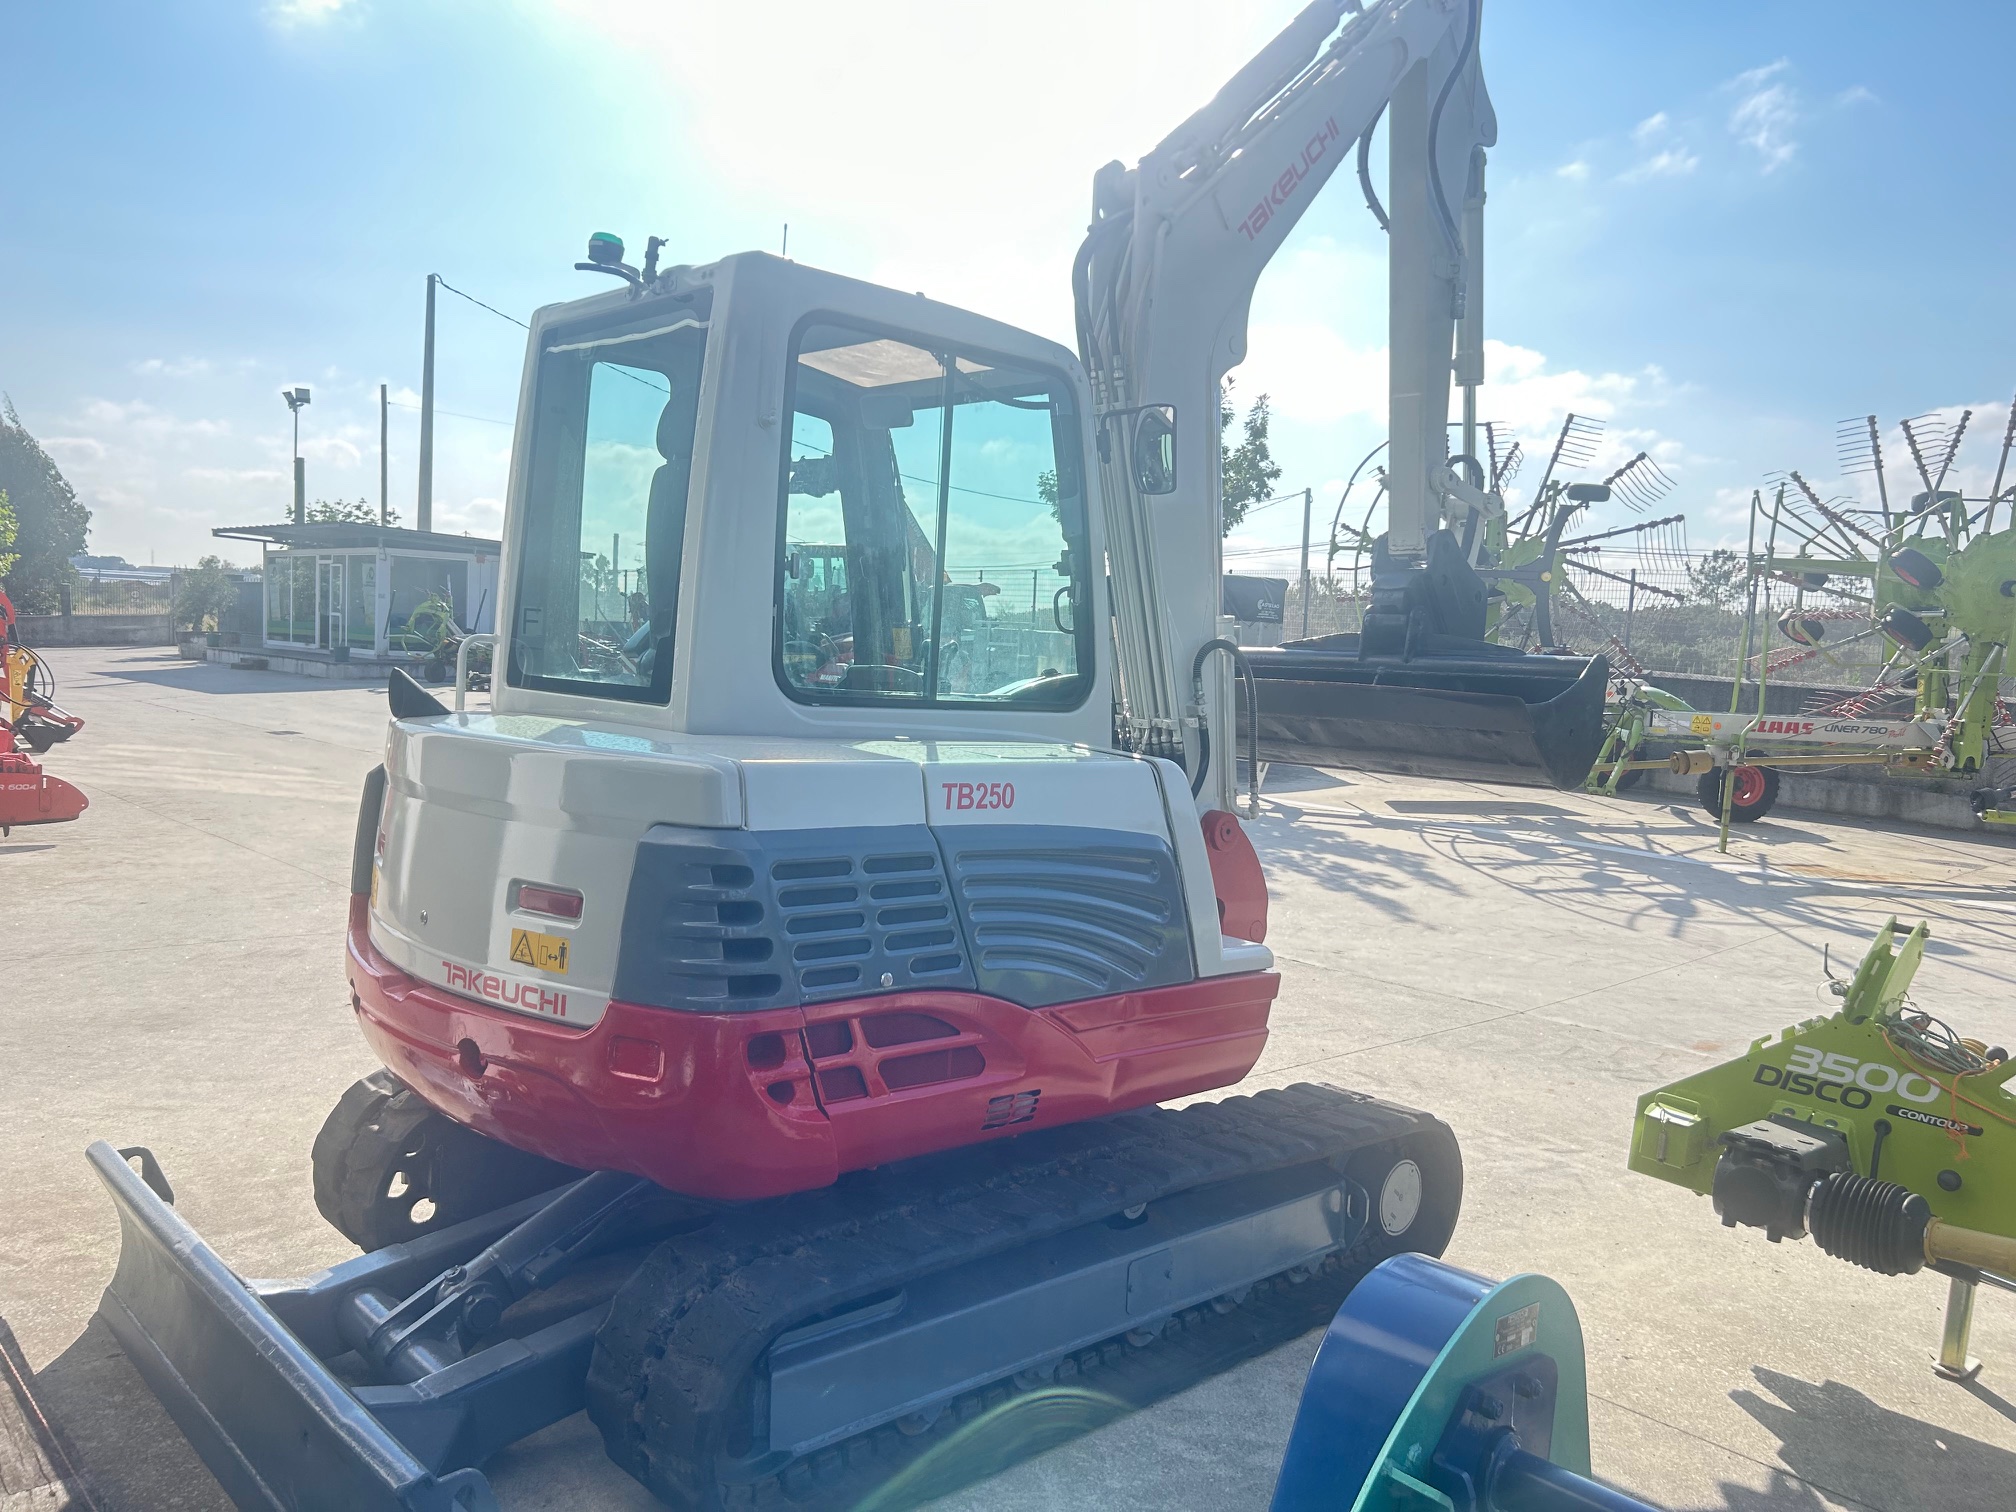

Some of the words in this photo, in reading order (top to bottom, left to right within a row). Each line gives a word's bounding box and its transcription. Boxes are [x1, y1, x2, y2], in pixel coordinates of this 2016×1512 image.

[1824, 724, 1860, 734] LINER
[1861, 726, 1889, 735] 780
[941, 782, 1015, 810] TB250
[1752, 1063, 1873, 1110] DISCO
[1785, 1044, 1941, 1103] 3500
